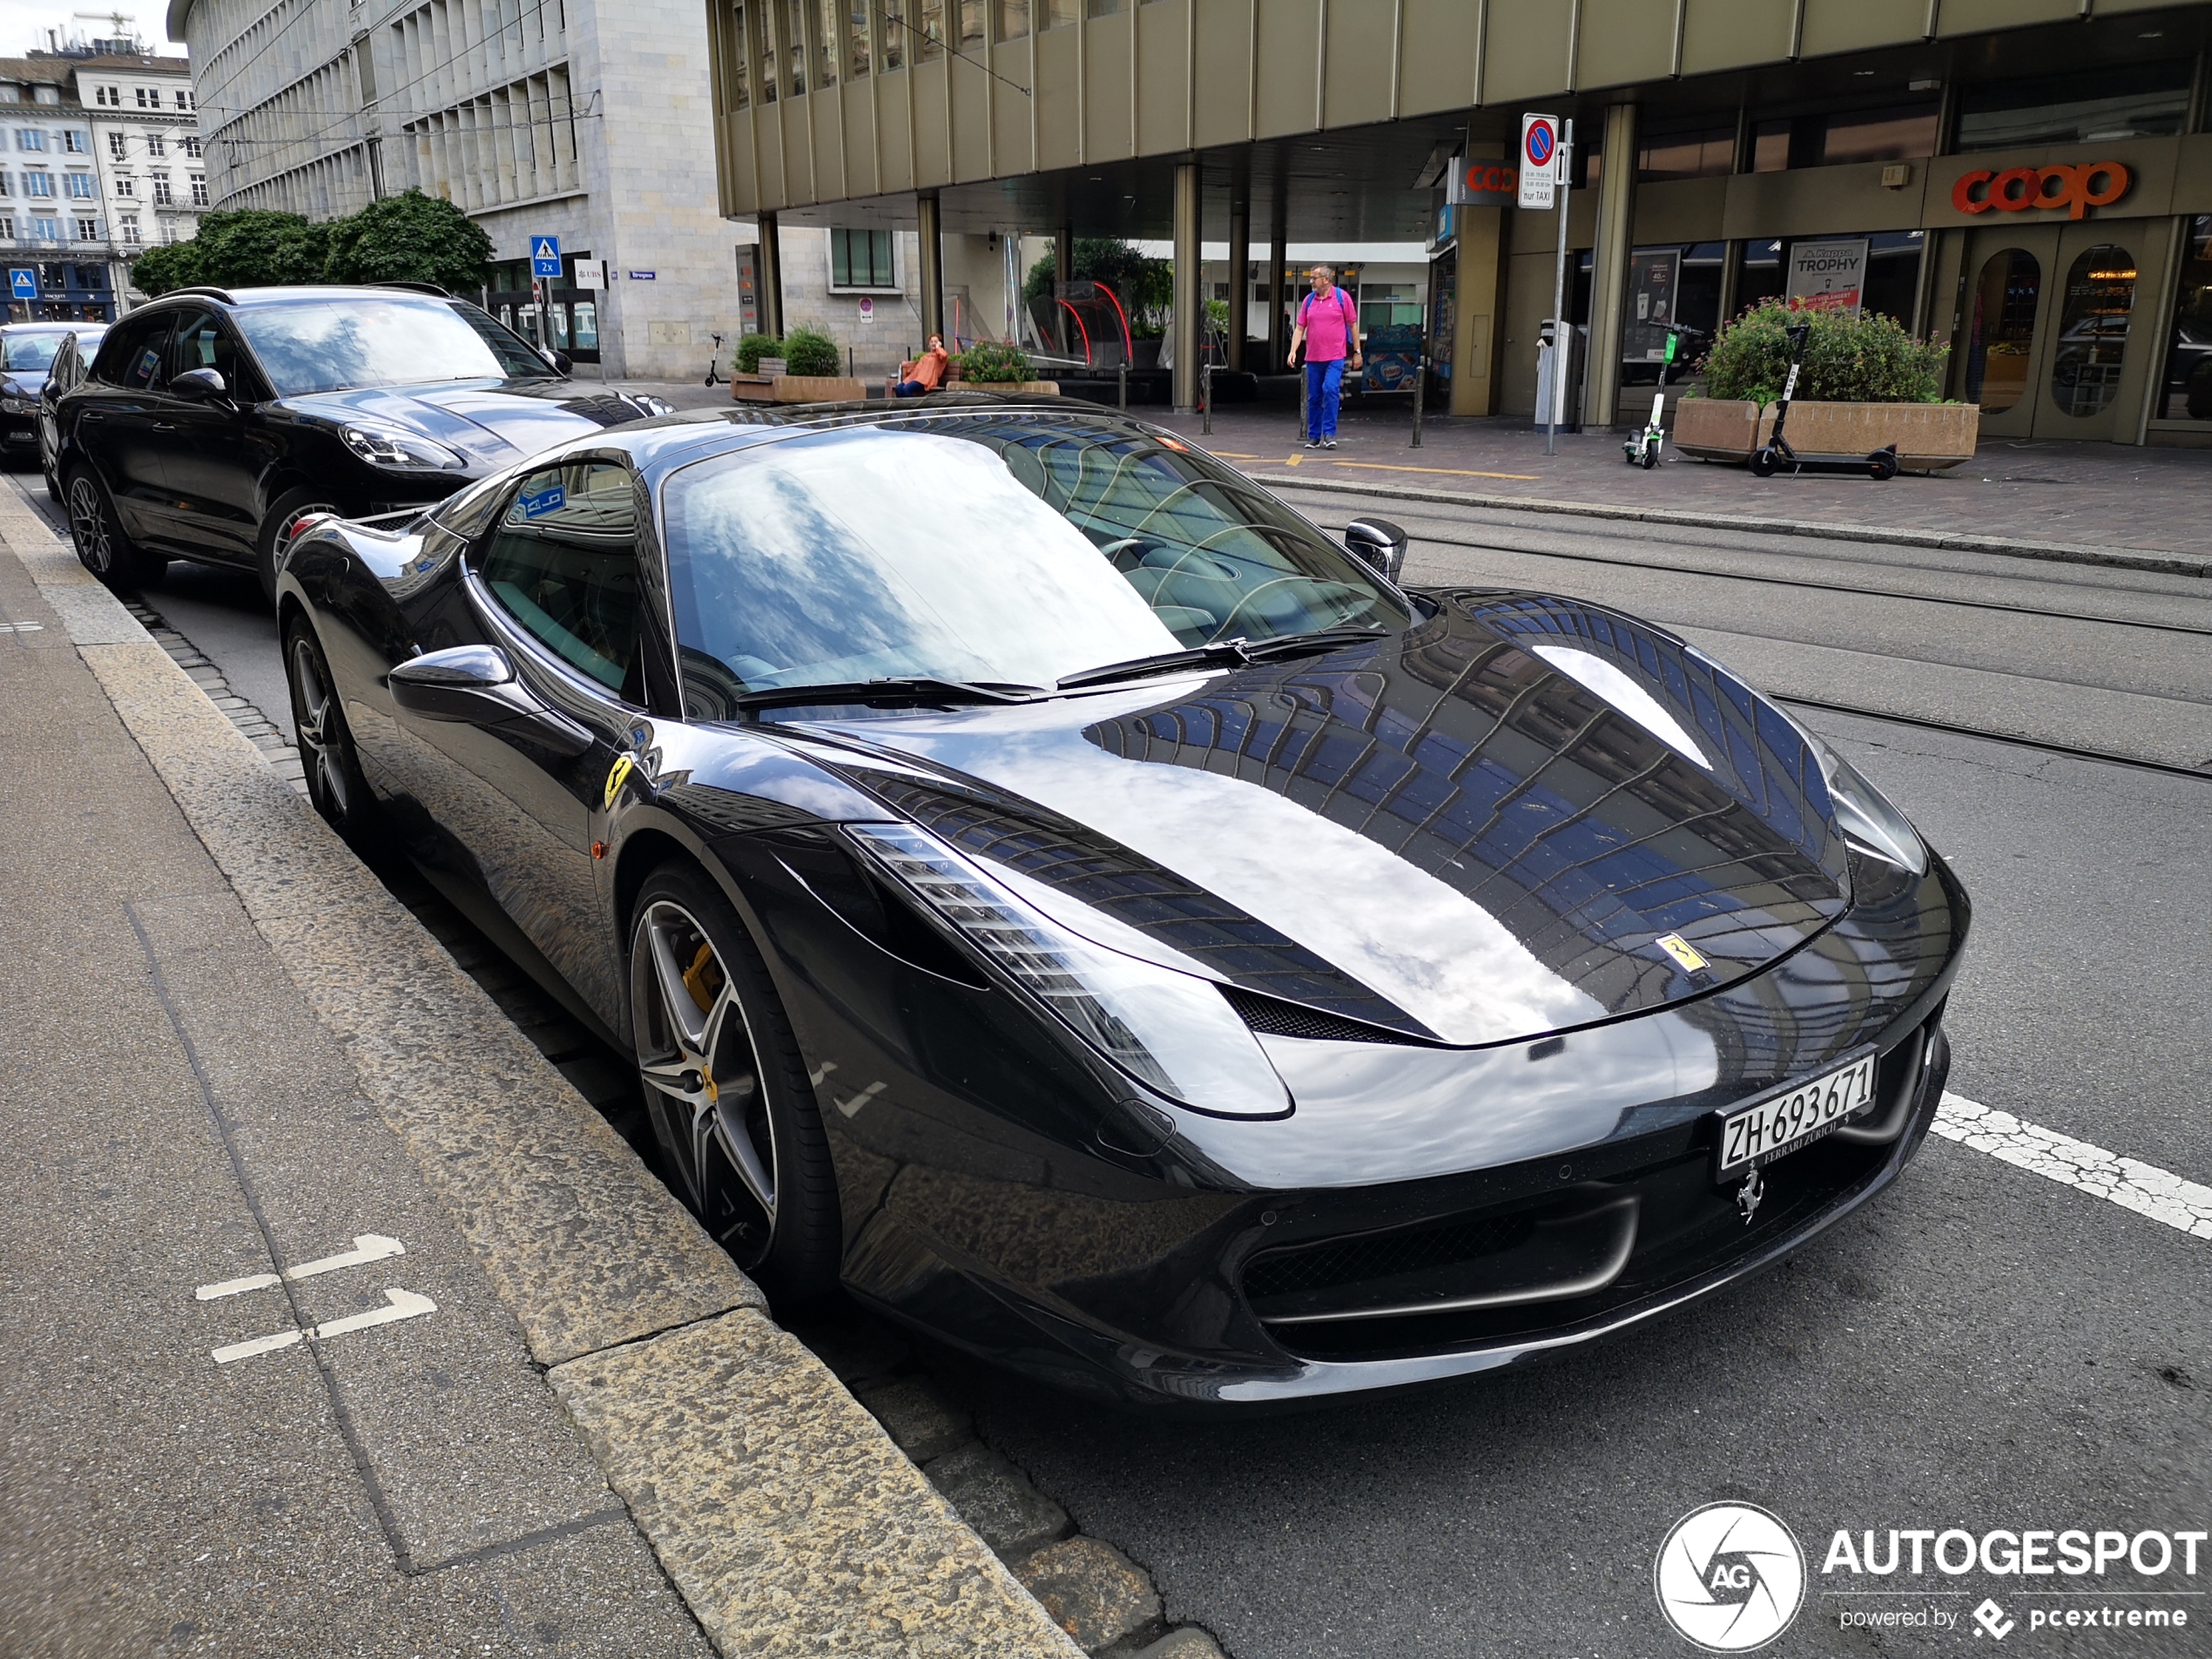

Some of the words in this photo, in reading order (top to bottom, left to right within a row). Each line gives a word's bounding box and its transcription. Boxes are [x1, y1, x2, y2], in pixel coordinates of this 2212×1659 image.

[1536, 191, 1550, 201] TAXI
[1952, 161, 2128, 219] coop
[1816, 248, 1853, 259] Kappa
[542, 262, 553, 272] 2x
[1797, 258, 1859, 272] TROPHY
[1785, 371, 1797, 394] BIRD
[1764, 1140, 1803, 1165] FERRARI
[1804, 1121, 1837, 1146] ZÜRICH
